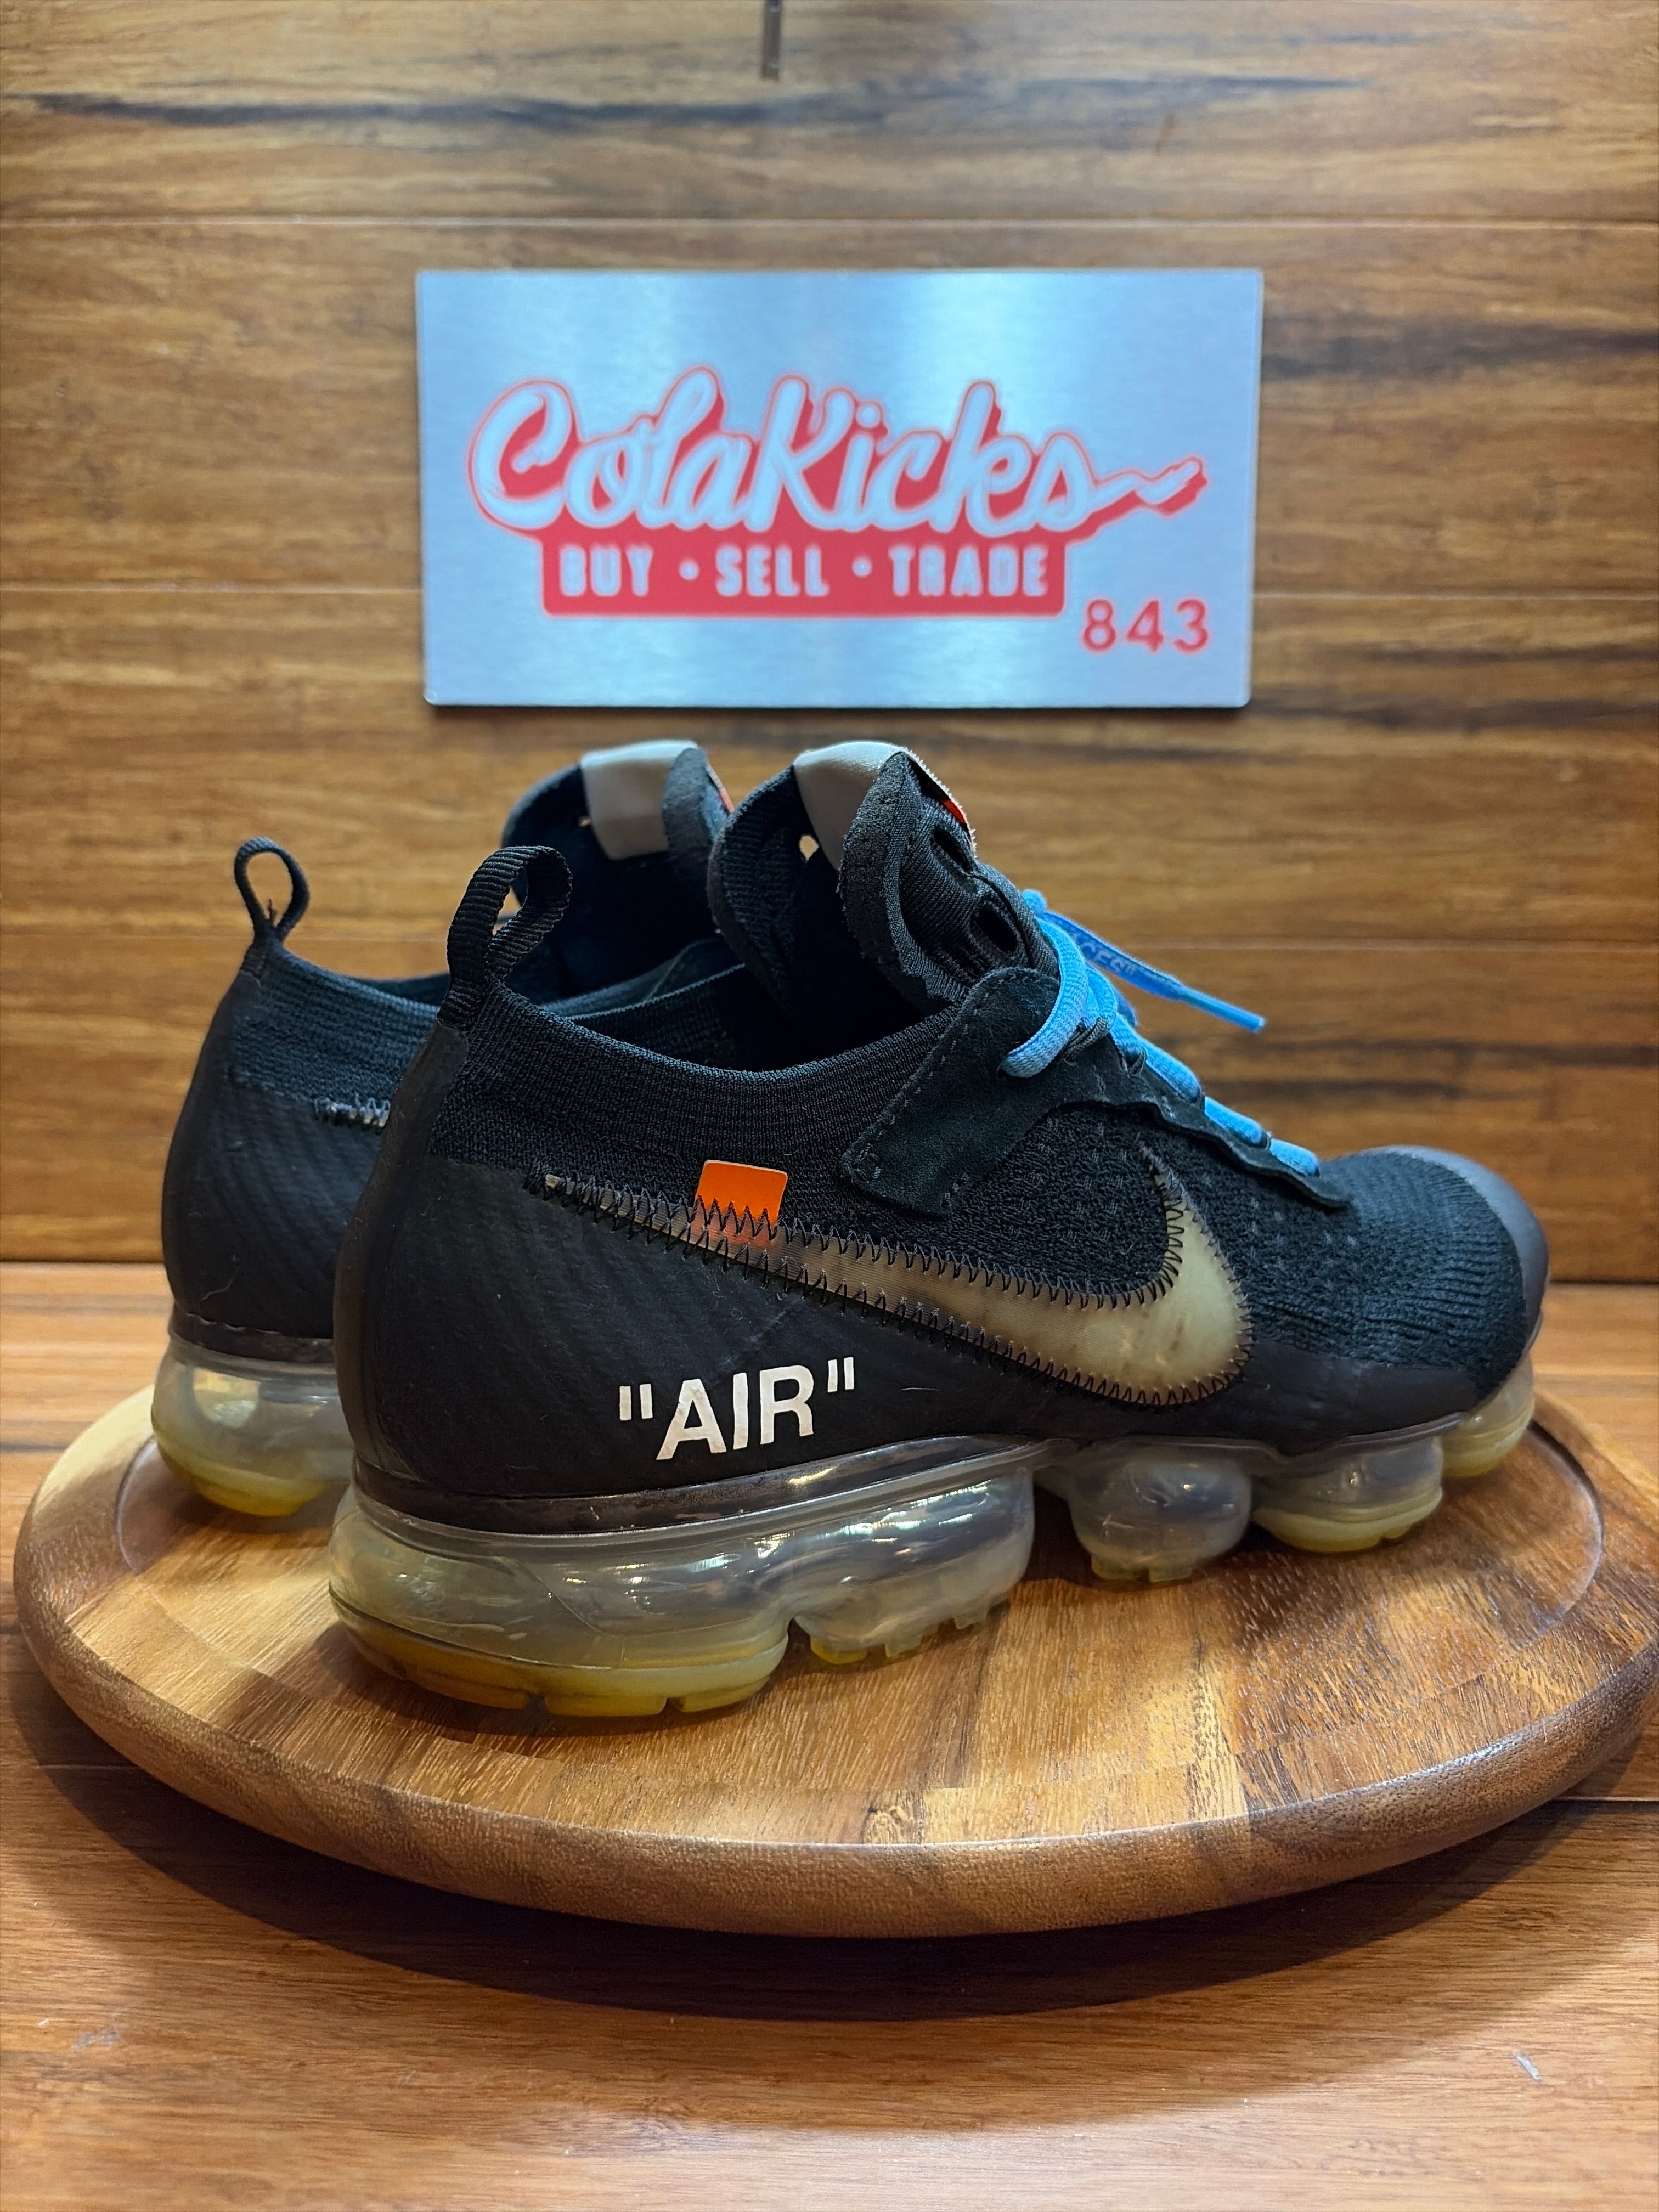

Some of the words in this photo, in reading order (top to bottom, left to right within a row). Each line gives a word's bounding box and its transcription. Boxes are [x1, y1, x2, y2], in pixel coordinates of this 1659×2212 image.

[470, 365, 1208, 540] ColaKicks
[558, 545, 654, 598] BUY
[714, 546, 829, 598] SELL
[888, 545, 1048, 597] TRADE
[1081, 597, 1209, 653] 843
[619, 1356, 854, 1460] "AIR"
